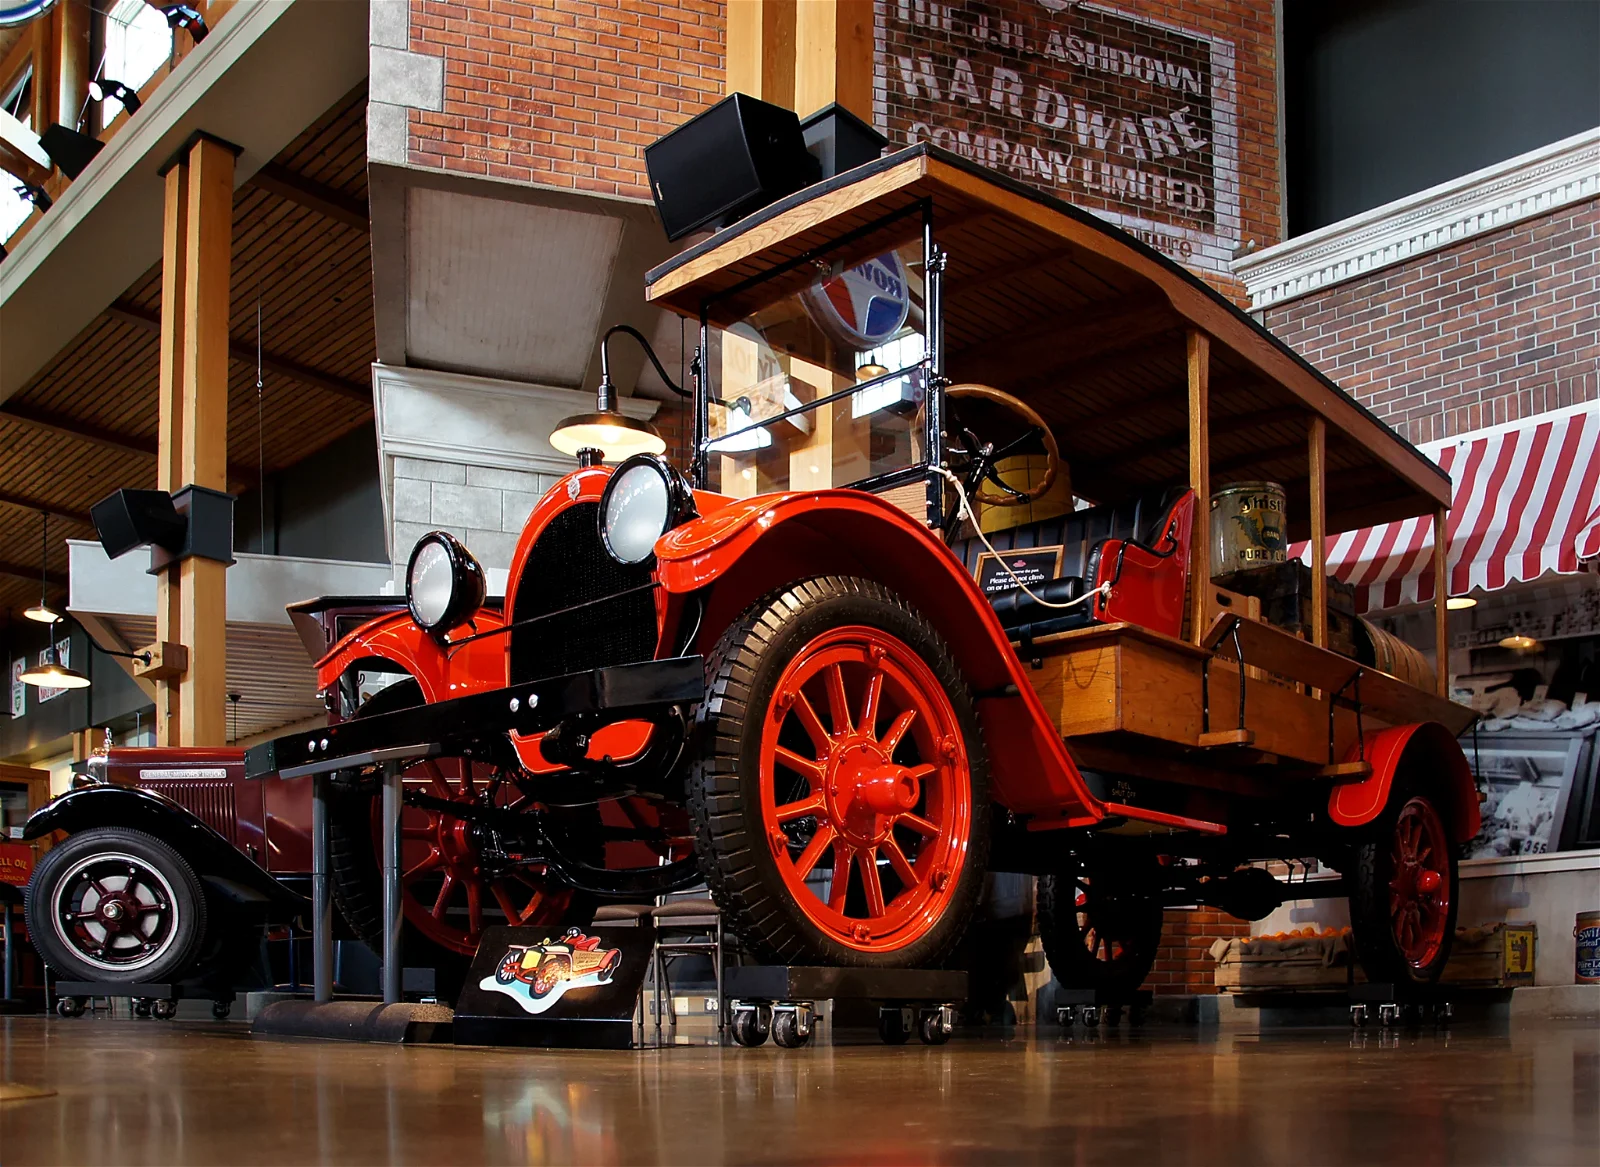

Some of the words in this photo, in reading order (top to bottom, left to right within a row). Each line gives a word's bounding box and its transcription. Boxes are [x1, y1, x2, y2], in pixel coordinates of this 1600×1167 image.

[1044, 29, 1202, 96] ASHDOWN
[898, 56, 1208, 162] HARDWARE
[906, 121, 1074, 185] COMPANY
[1082, 158, 1207, 214] LIMITED
[1239, 549, 1268, 560] PURE
[1028, 573, 1045, 581] climb
[1118, 781, 1131, 790] FUEL
[1112, 788, 1125, 796] SHUT
[14, 858, 28, 870] OIL
